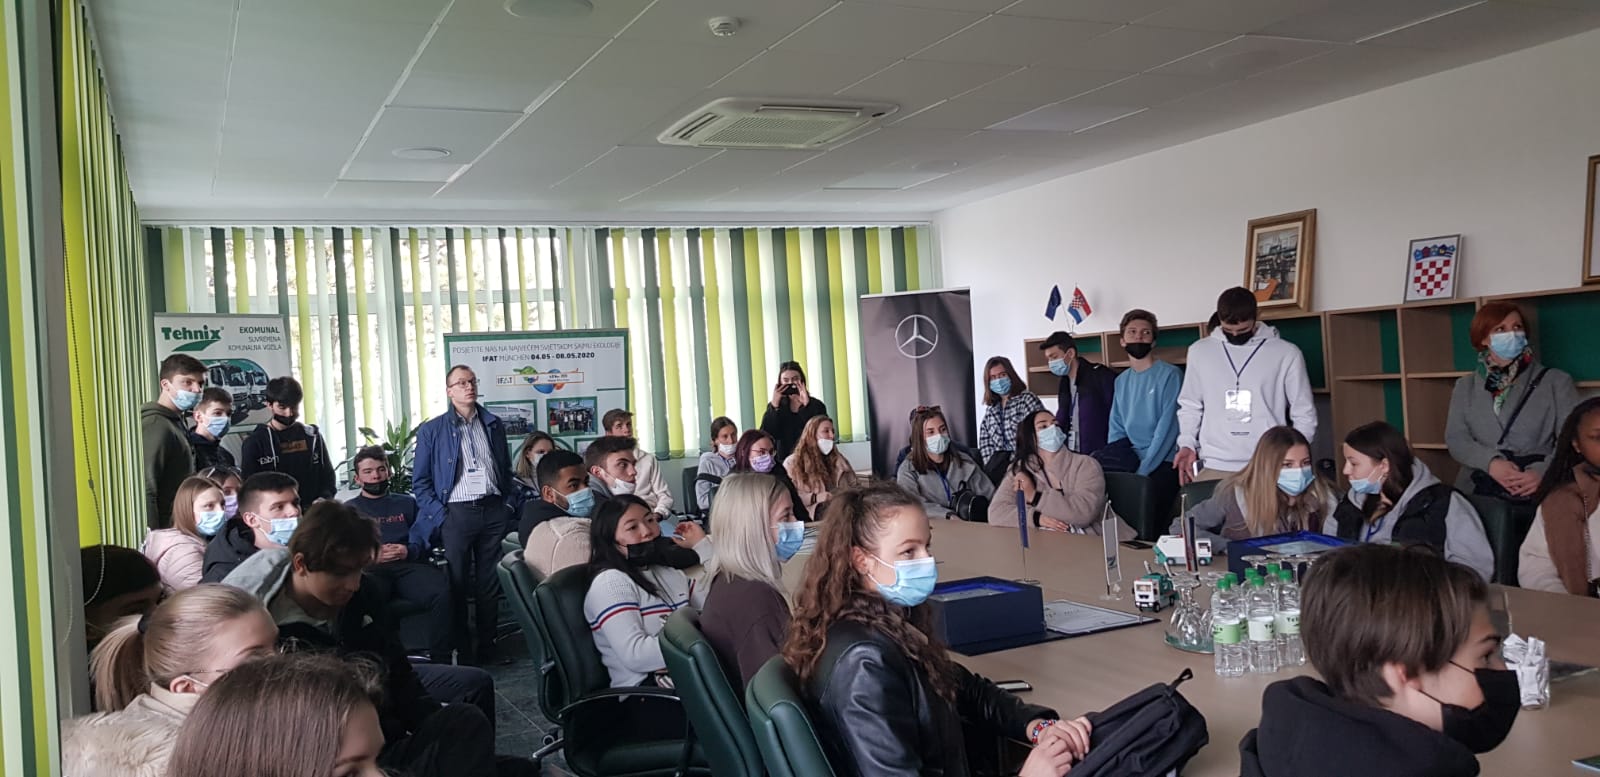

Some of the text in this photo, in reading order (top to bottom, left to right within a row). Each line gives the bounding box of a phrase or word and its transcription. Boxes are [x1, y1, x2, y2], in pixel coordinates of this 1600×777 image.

[161, 325, 221, 340] Tehnix
[239, 326, 280, 334] EKOMUNAL
[452, 346, 484, 354] POSJETITE
[484, 345, 498, 353] NAS
[530, 353, 550, 361] 04.05
[556, 352, 595, 360] 08.05.2020
